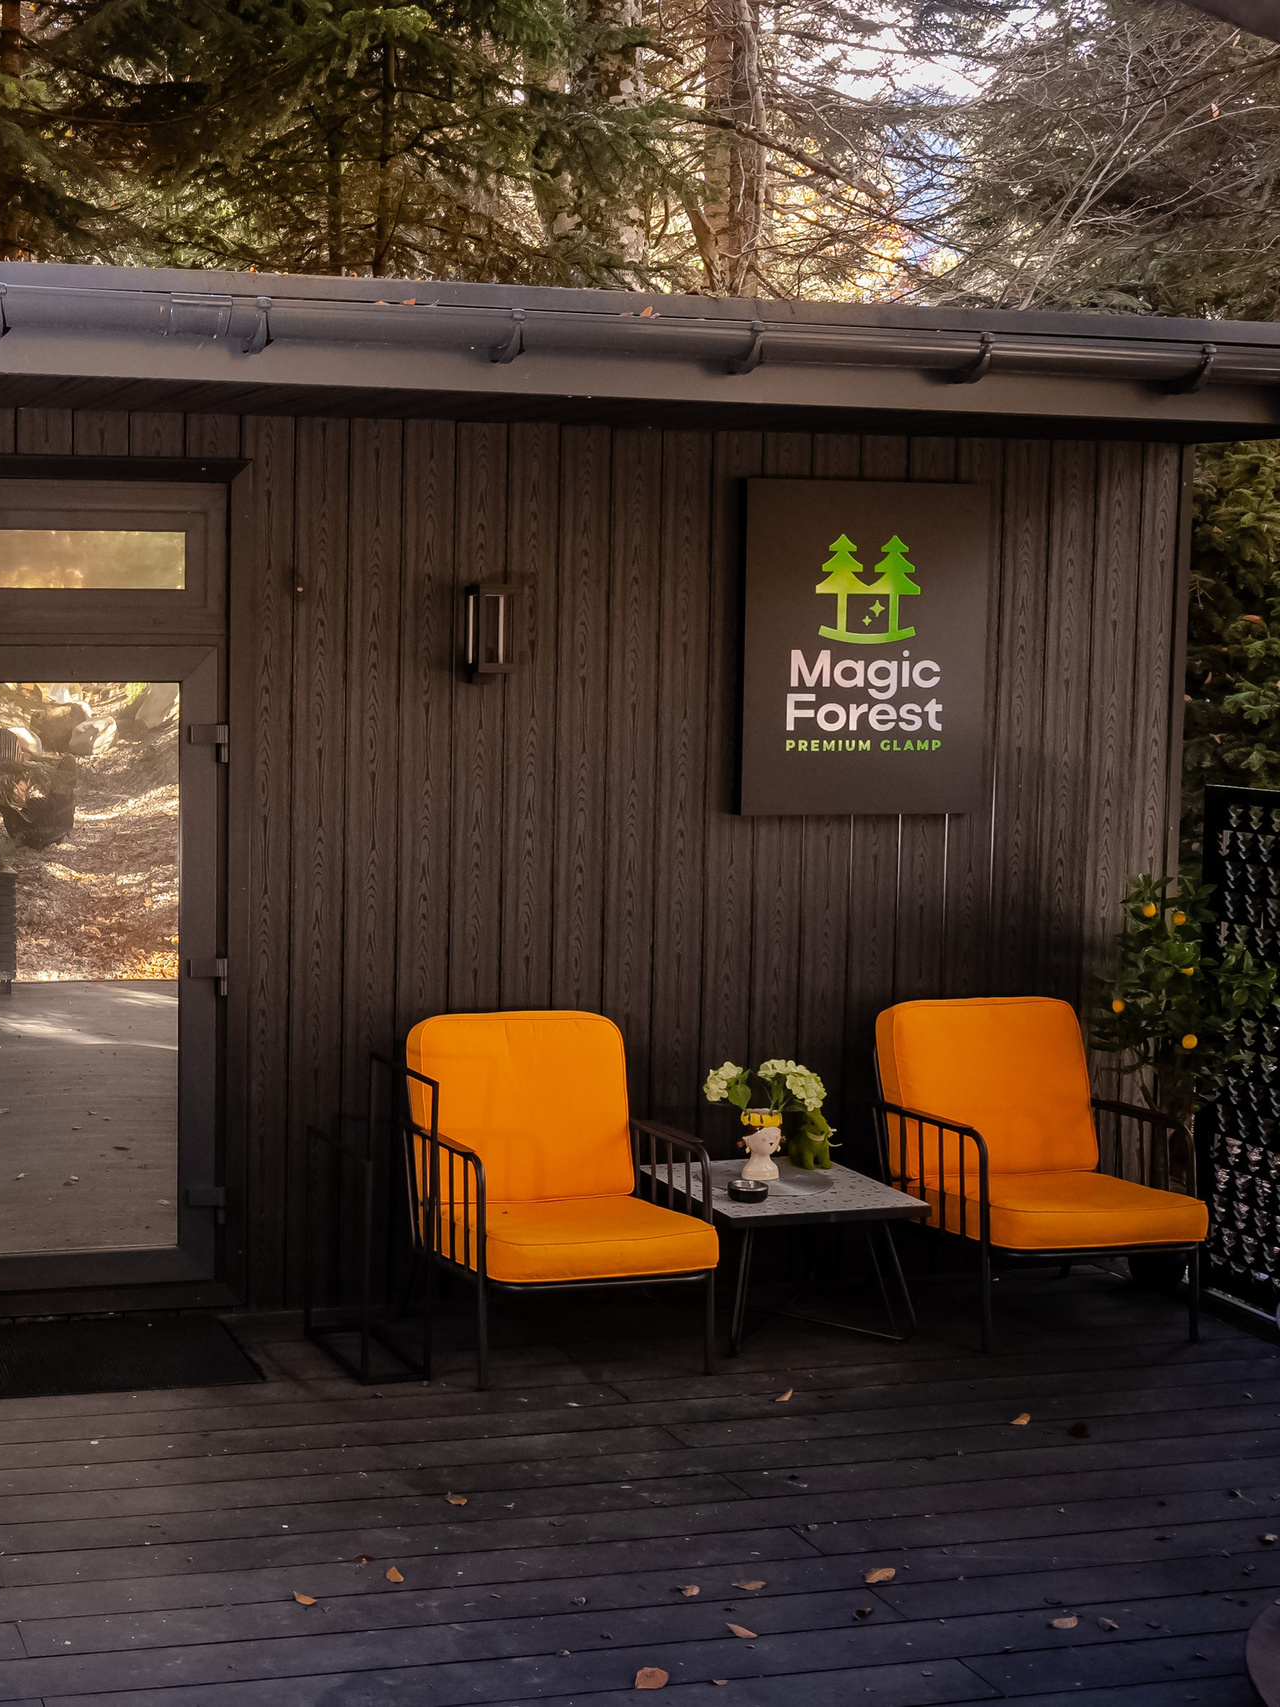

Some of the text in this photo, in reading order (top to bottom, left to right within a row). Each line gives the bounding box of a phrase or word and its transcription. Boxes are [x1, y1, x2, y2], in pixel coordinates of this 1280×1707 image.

[790, 649, 941, 700] Magic
[785, 693, 943, 732] Forest
[785, 739, 942, 752] PREMIUM GLAMP
